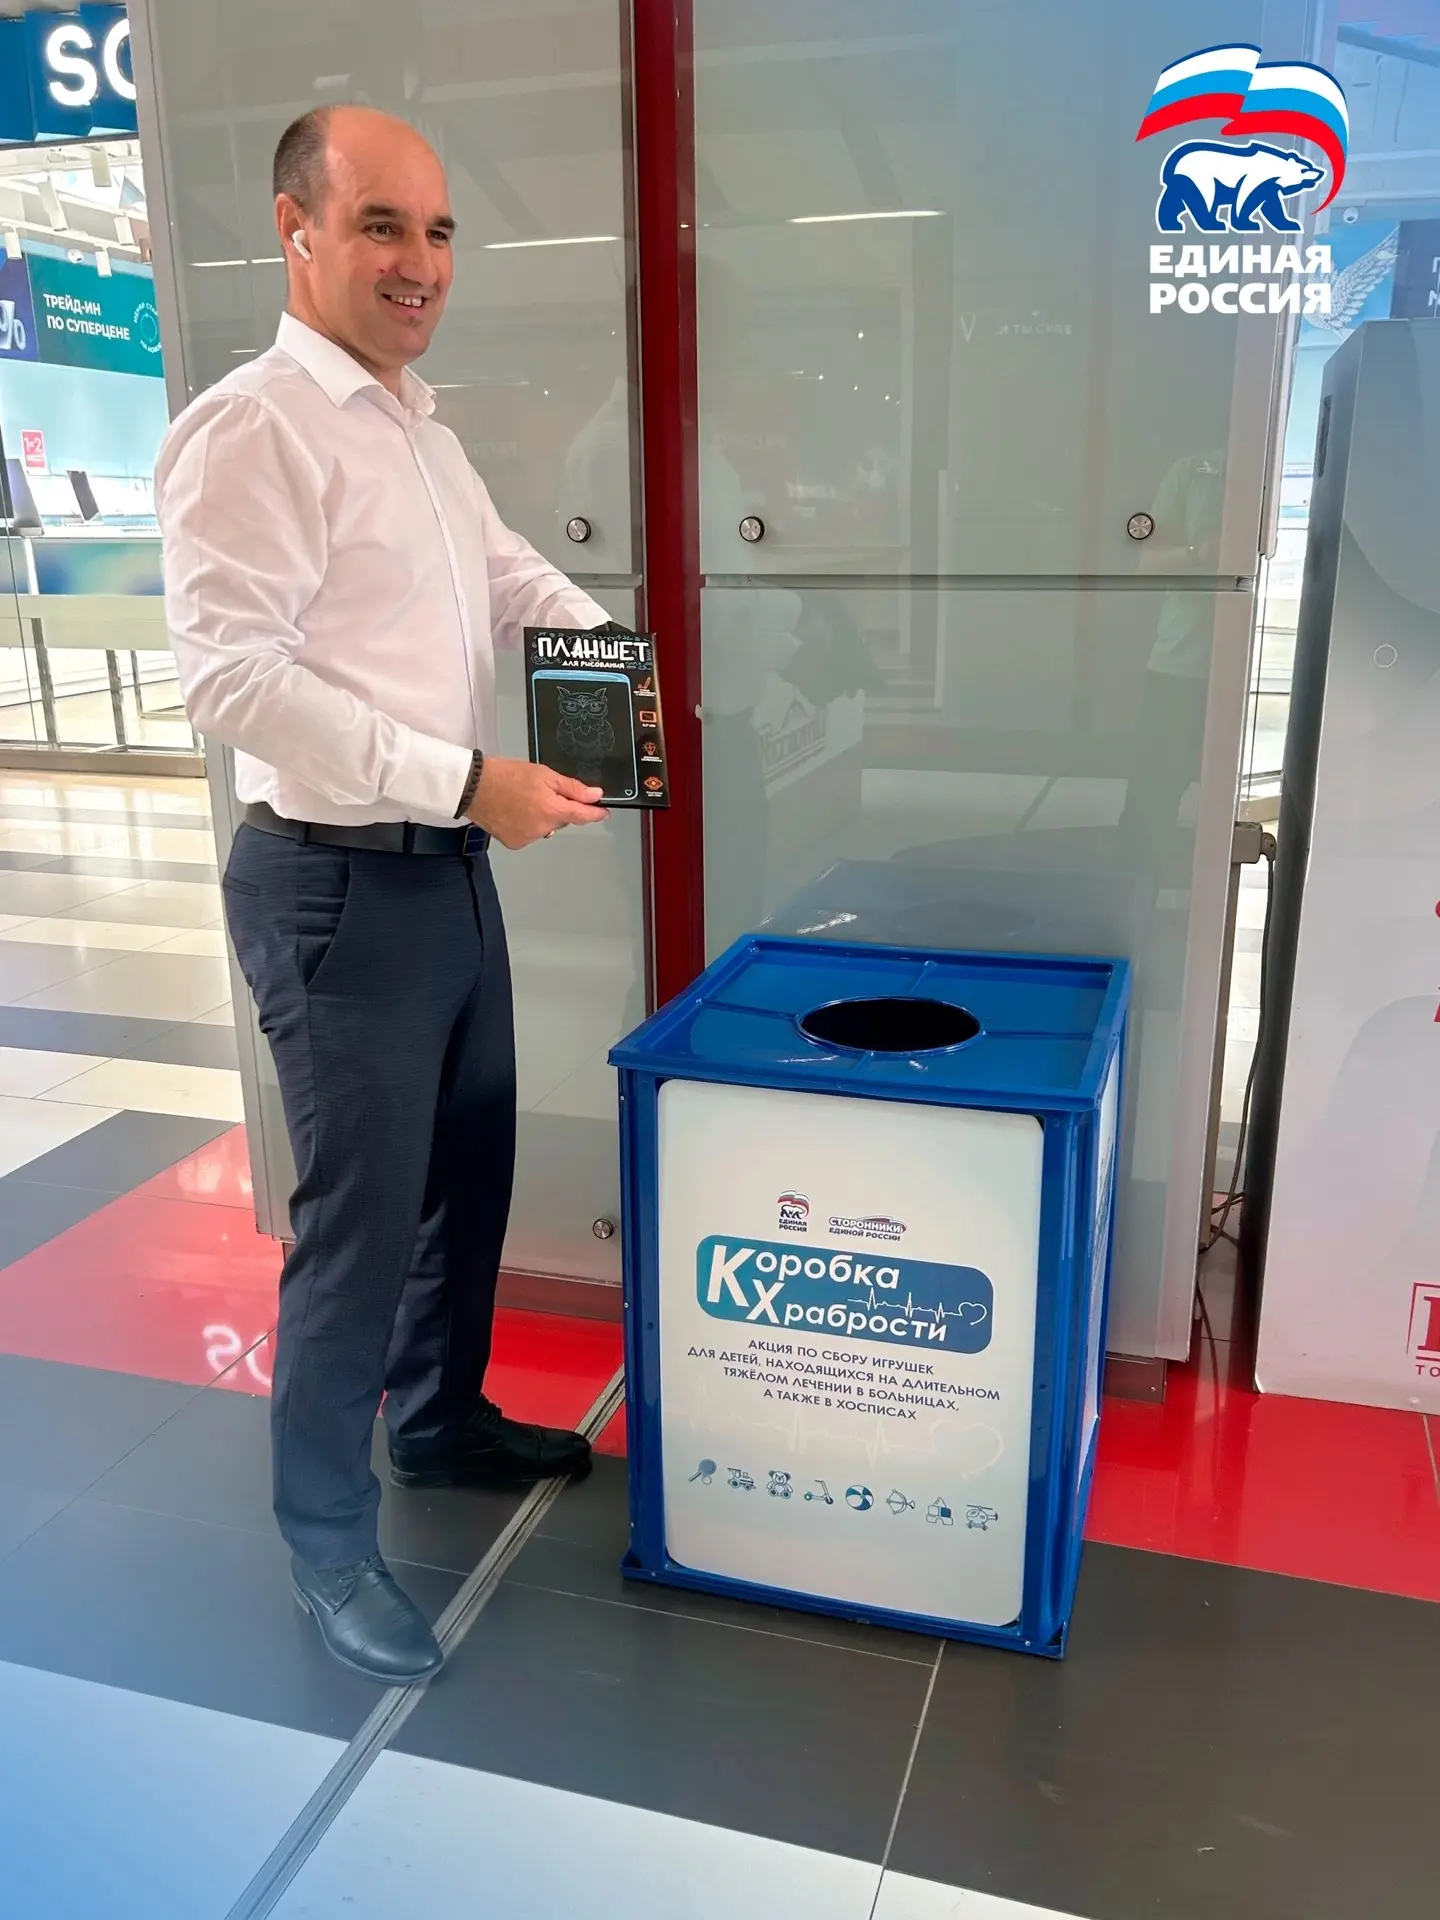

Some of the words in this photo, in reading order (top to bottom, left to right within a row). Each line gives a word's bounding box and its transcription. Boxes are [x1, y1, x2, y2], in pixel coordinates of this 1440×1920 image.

[43, 293, 102, 316] ТРЕЙД-ИН
[46, 315, 64, 330] ПО
[66, 317, 130, 340] СУПЕРЦЕНЕ
[537, 637, 649, 662] ПЛАНШЕТ
[581, 660, 625, 669] РИСОВАНИЯ
[779, 1218, 807, 1226] ЕДИНАЯ
[779, 1224, 807, 1232] РОССИЯ
[829, 1217, 901, 1234] СТОРОННИКИ
[829, 1228, 864, 1237] ЕДИНОЙ
[866, 1232, 901, 1241] РОССИИ
[707, 1244, 900, 1308] Коробка
[745, 1278, 947, 1341] Храбрости
[748, 1339, 793, 1355] АКЦИЯ
[797, 1346, 818, 1358] ПО
[822, 1350, 868, 1365] СБОРУ
[872, 1357, 934, 1375] ИГРУШЕК
[687, 1346, 716, 1359] ДЛЯ
[719, 1351, 762, 1367] ДЕТЕЙ,
[766, 1357, 874, 1382] НАХОДЯЩИХСЯ
[878, 1374, 898, 1386] НА
[902, 1378, 1000, 1401] ДЛИТЕЛЬНОМ
[724, 1366, 788, 1385] ТЯЖЁЛОМ
[792, 1378, 852, 1395] ЛЕЧЕНИИ
[856, 1387, 864, 1396] В
[869, 1388, 960, 1412] БОЛЬНИЦАХ,
[763, 1389, 773, 1399] А
[777, 1390, 820, 1405] ТАКЖЕ
[824, 1397, 832, 1407] В
[836, 1399, 917, 1420] ХОСПИСАХ
